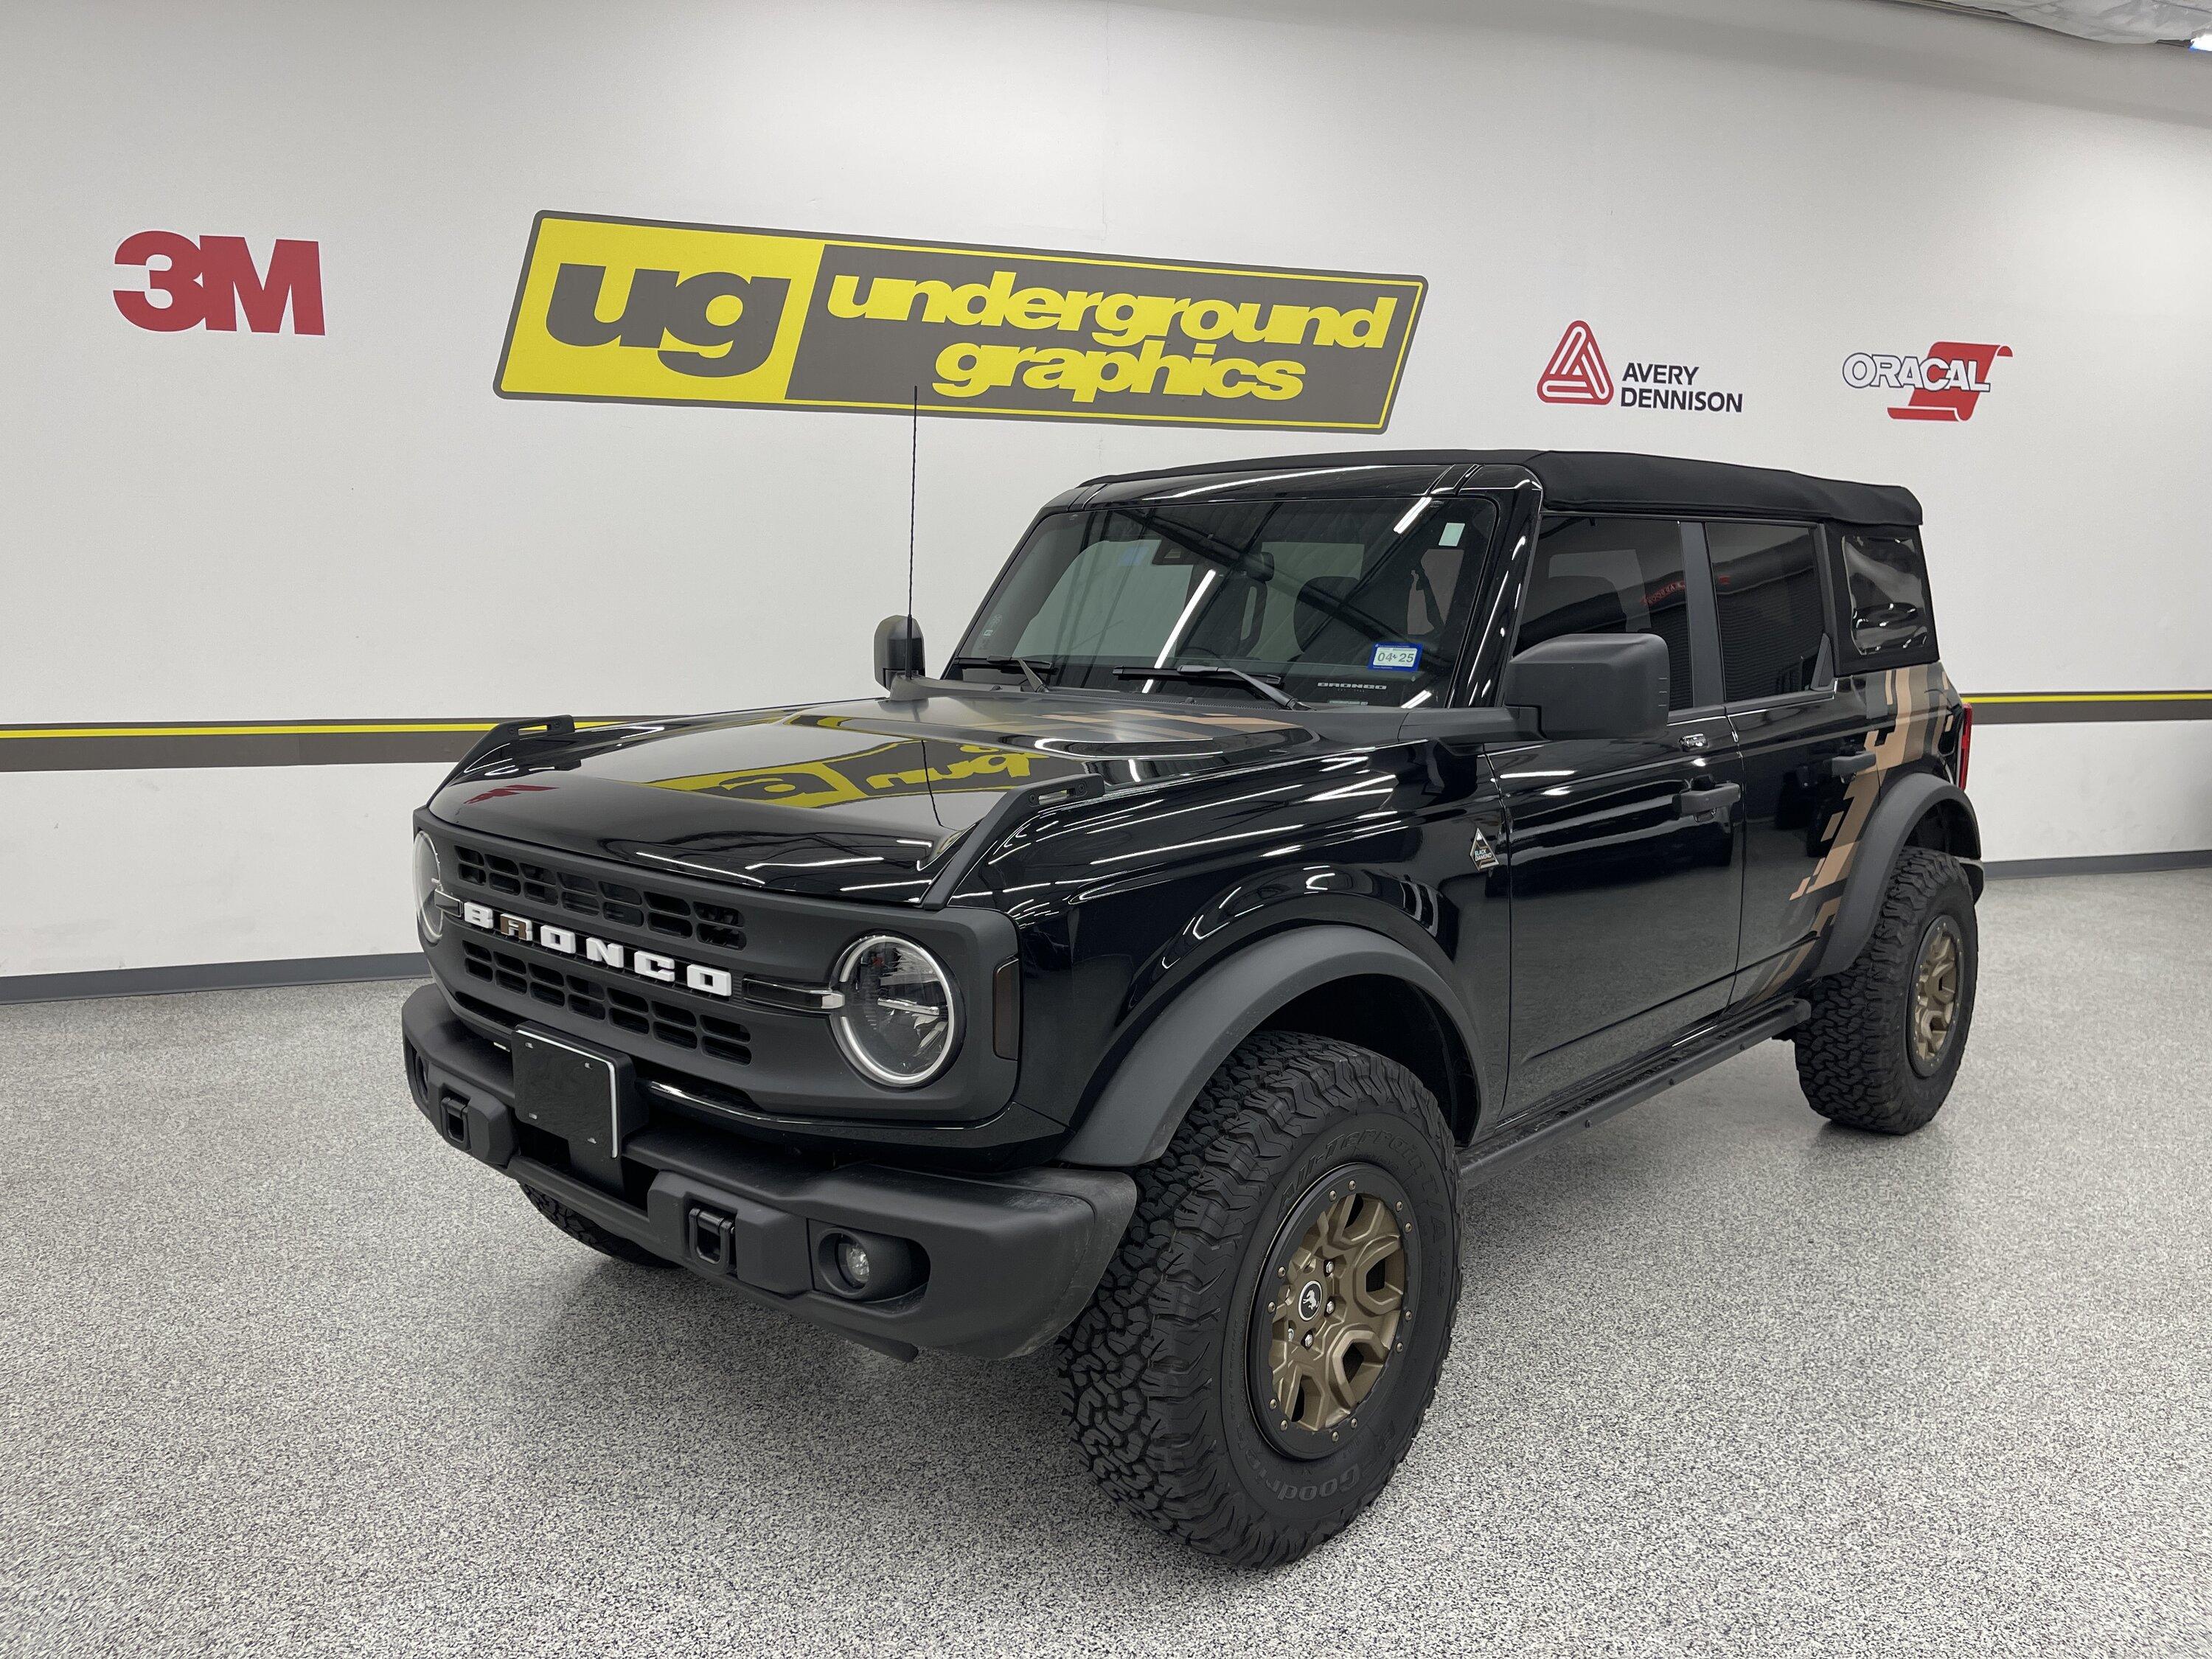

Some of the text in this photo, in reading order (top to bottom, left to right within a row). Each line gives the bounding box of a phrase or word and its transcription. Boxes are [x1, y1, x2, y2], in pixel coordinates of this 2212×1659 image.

[113, 230, 325, 335] 3M
[827, 271, 1398, 349] underground
[546, 262, 790, 378] ug
[932, 340, 1307, 403] graphics
[1621, 362, 1700, 386] AVERY
[1621, 386, 1743, 413] DENNISON
[1843, 352, 1991, 393] ORACAL
[1377, 653, 1414, 663] 04 25
[464, 901, 732, 997] BRONCO
